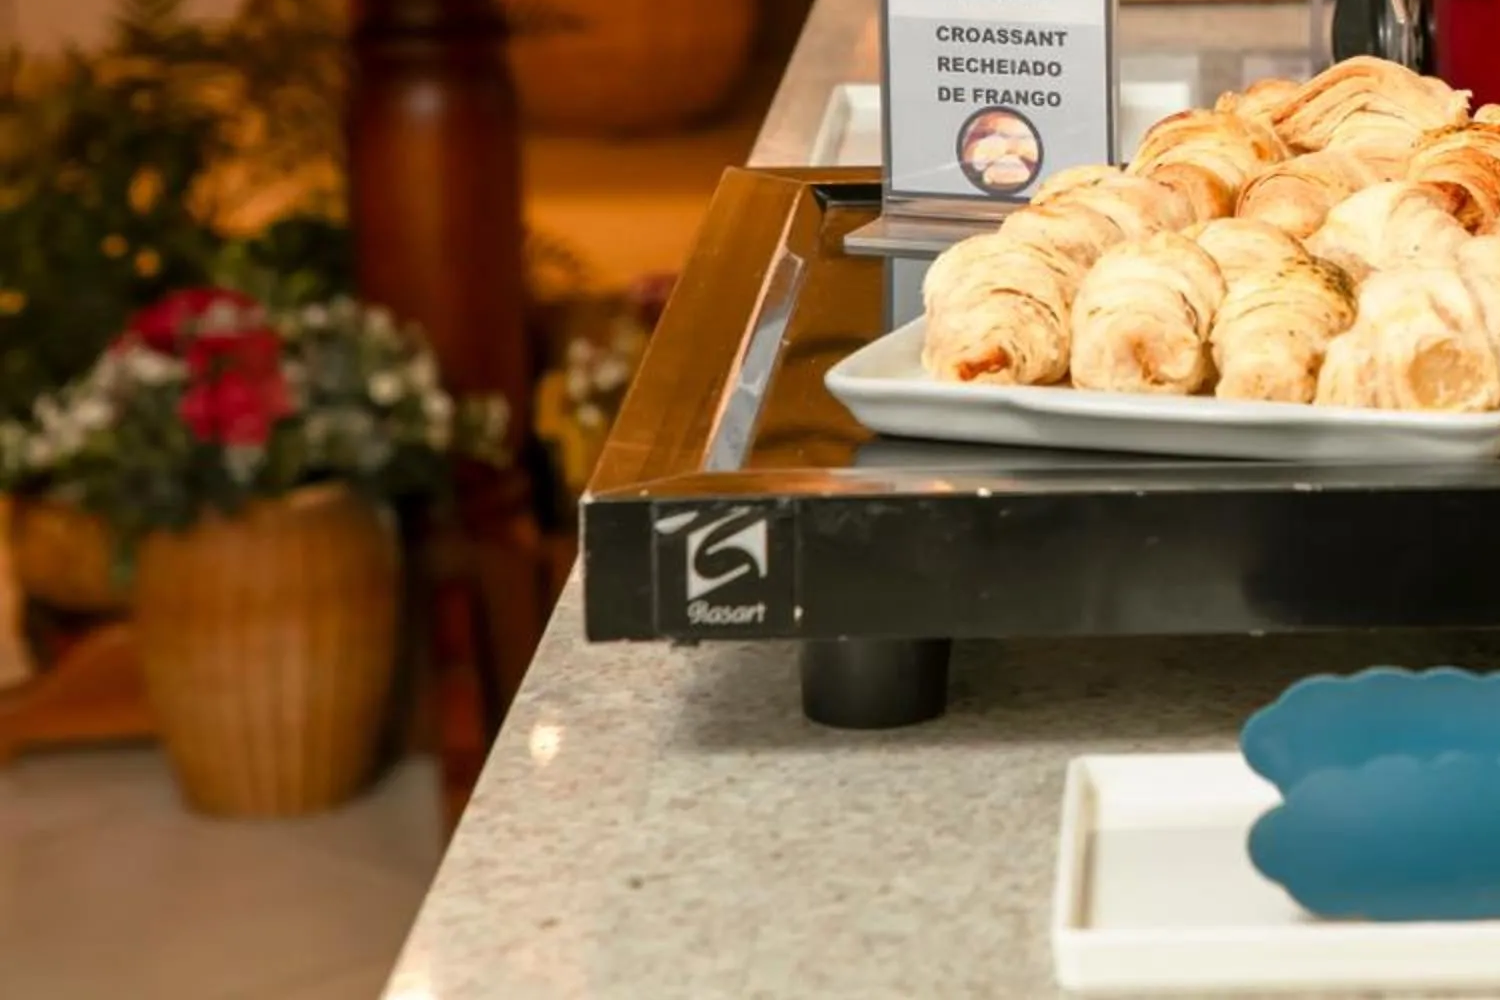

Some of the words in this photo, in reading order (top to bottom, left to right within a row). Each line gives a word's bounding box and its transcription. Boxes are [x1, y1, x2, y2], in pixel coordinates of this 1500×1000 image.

[935, 25, 1068, 47] CROASSANT
[937, 55, 1063, 77] RECHEIADO
[937, 86, 966, 102] DE
[972, 87, 1062, 107] FRANGO
